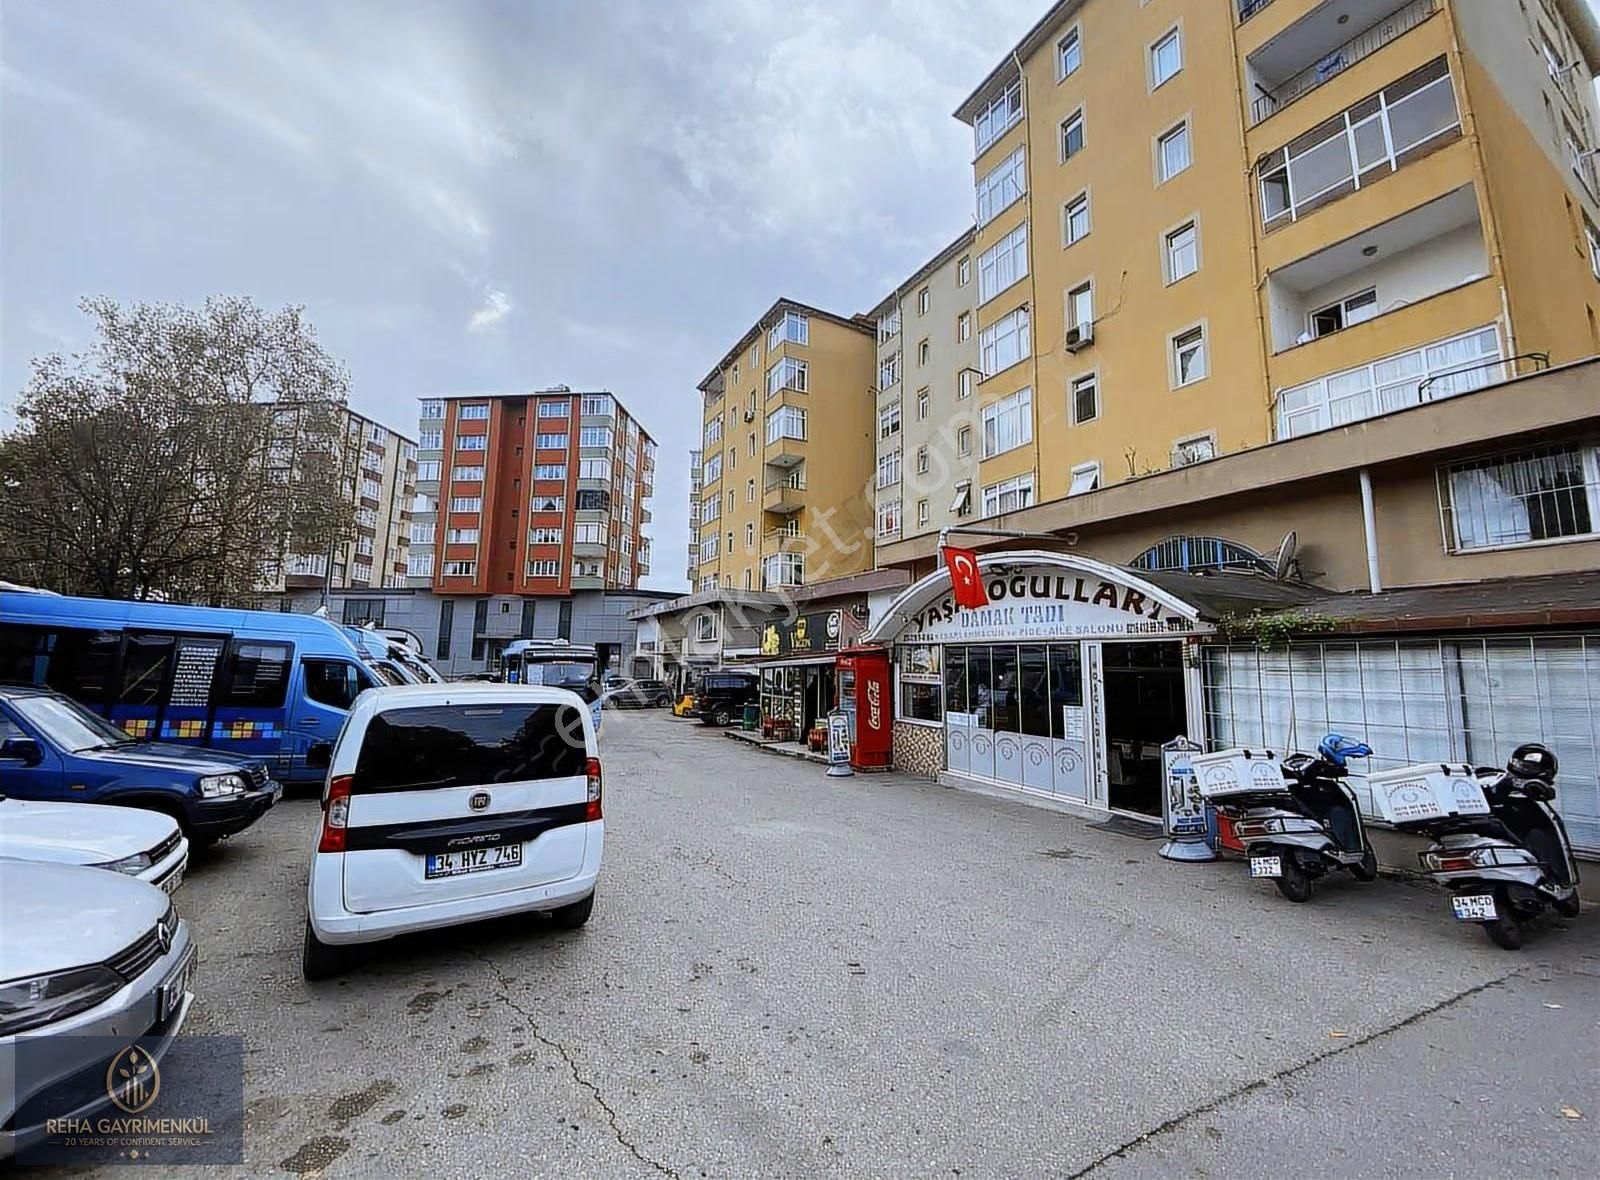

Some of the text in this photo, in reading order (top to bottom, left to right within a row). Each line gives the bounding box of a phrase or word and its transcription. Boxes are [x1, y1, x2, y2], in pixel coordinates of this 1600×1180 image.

[961, 607, 1014, 628] DAMAK
[1075, 623, 1123, 635] SALONU
[437, 856, 453, 872] 34
[461, 850, 488, 867] HYZ
[495, 845, 519, 862] 746
[1454, 898, 1468, 908] 34
